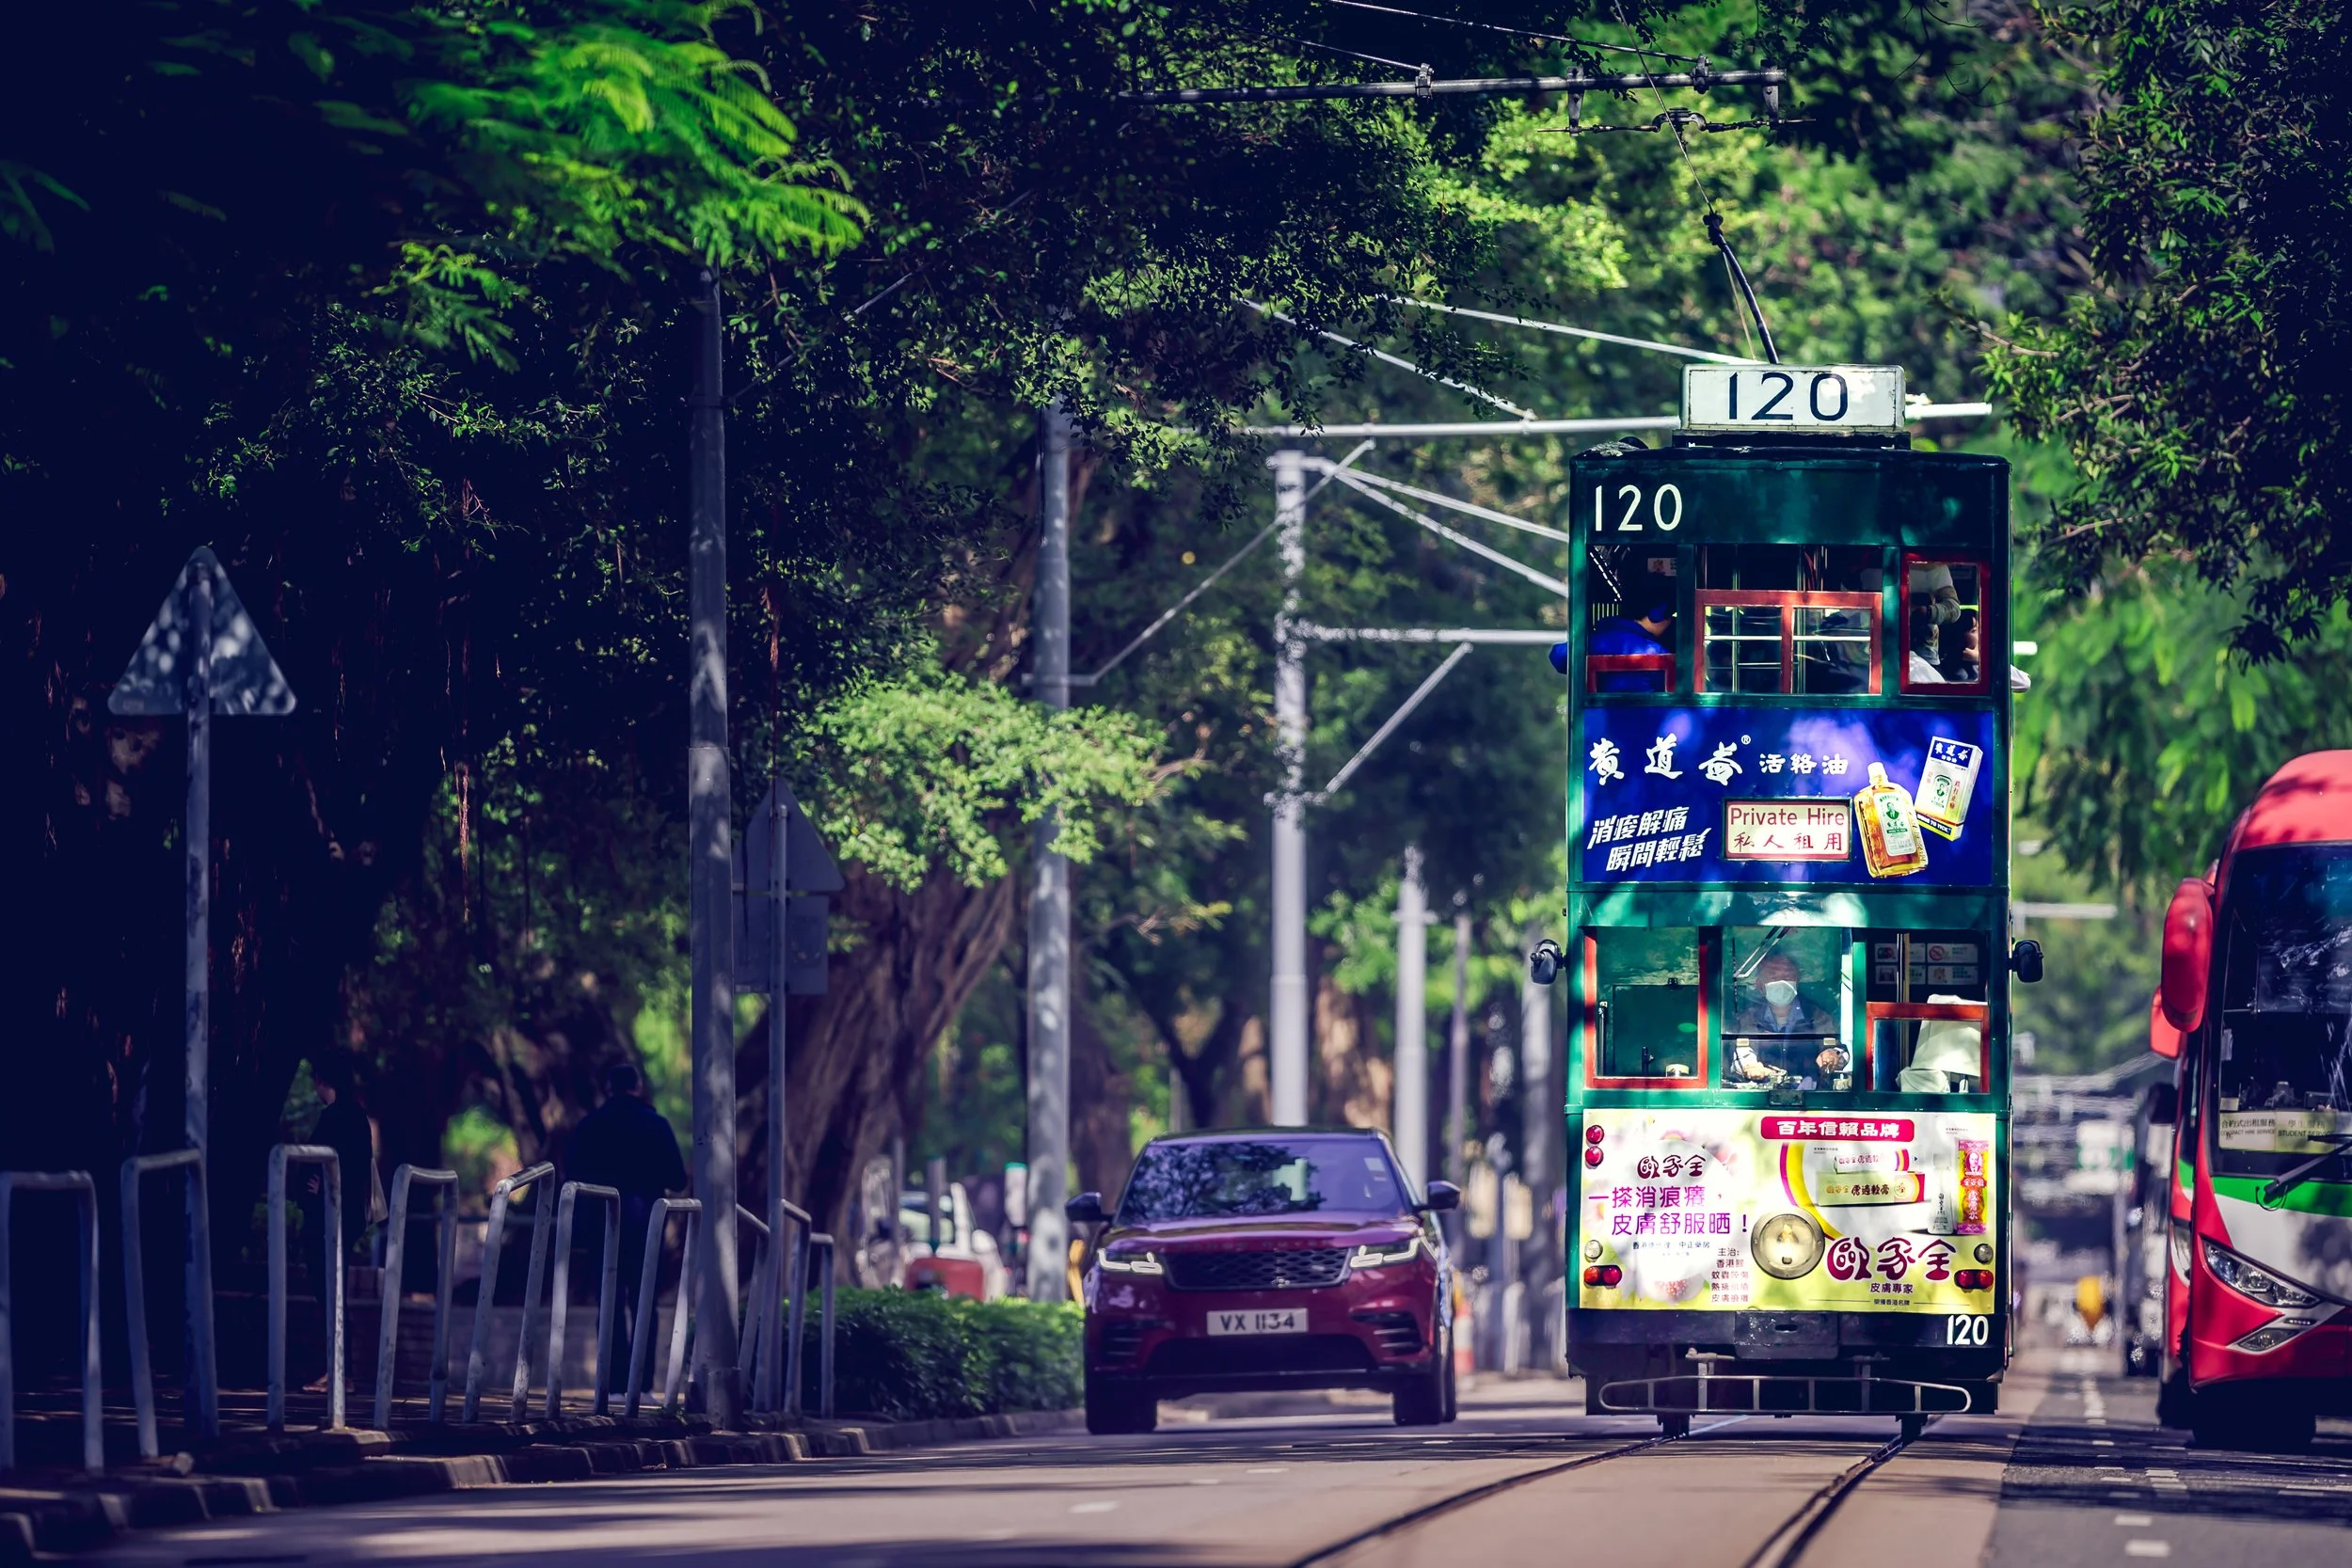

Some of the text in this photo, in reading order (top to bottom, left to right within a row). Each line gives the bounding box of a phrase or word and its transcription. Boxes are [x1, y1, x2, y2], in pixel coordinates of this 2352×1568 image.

[1728, 372, 1848, 420] 120
[1595, 483, 1683, 531] 120
[1758, 752, 1849, 775] 活絡油
[1586, 806, 1690, 850] 消痠解痛
[1730, 807, 1845, 826] Private Hire
[1605, 828, 1712, 872] 瞬間輕鬆
[1734, 832, 1843, 852] 私人租用
[1776, 1119, 1900, 1139] 百年信賴品牌
[1870, 1282, 1914, 1294] 皮膚專家
[1220, 1312, 1295, 1331] VX 1134
[1946, 1314, 1990, 1346] 120
